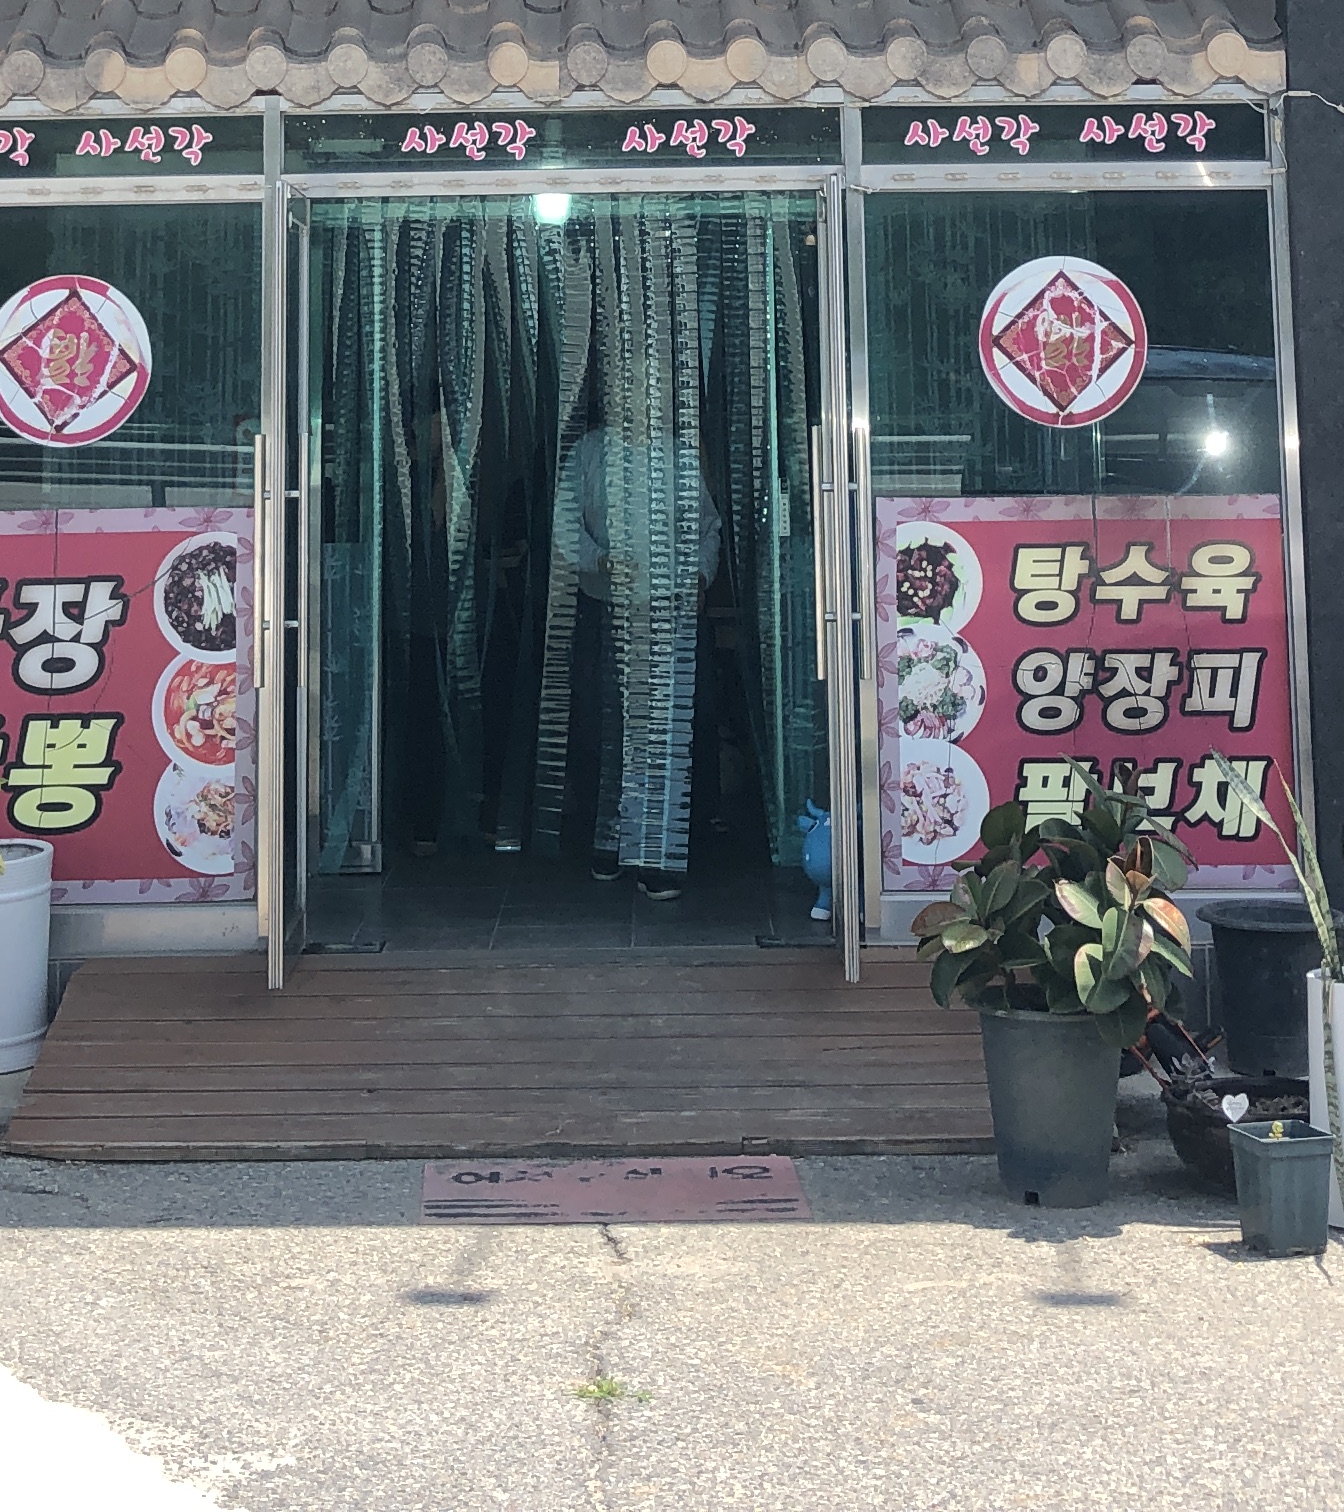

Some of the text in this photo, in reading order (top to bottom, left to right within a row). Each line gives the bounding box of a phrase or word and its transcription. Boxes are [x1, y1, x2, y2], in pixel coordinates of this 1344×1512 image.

[75, 124, 213, 167] 사선각
[400, 119, 536, 160] 사선각
[622, 116, 756, 158] 사선각
[904, 114, 1040, 156] 사선각
[1079, 111, 1216, 153] 사선각
[1010, 541, 1262, 626] 탕수육
[1013, 647, 1268, 735] 양장피
